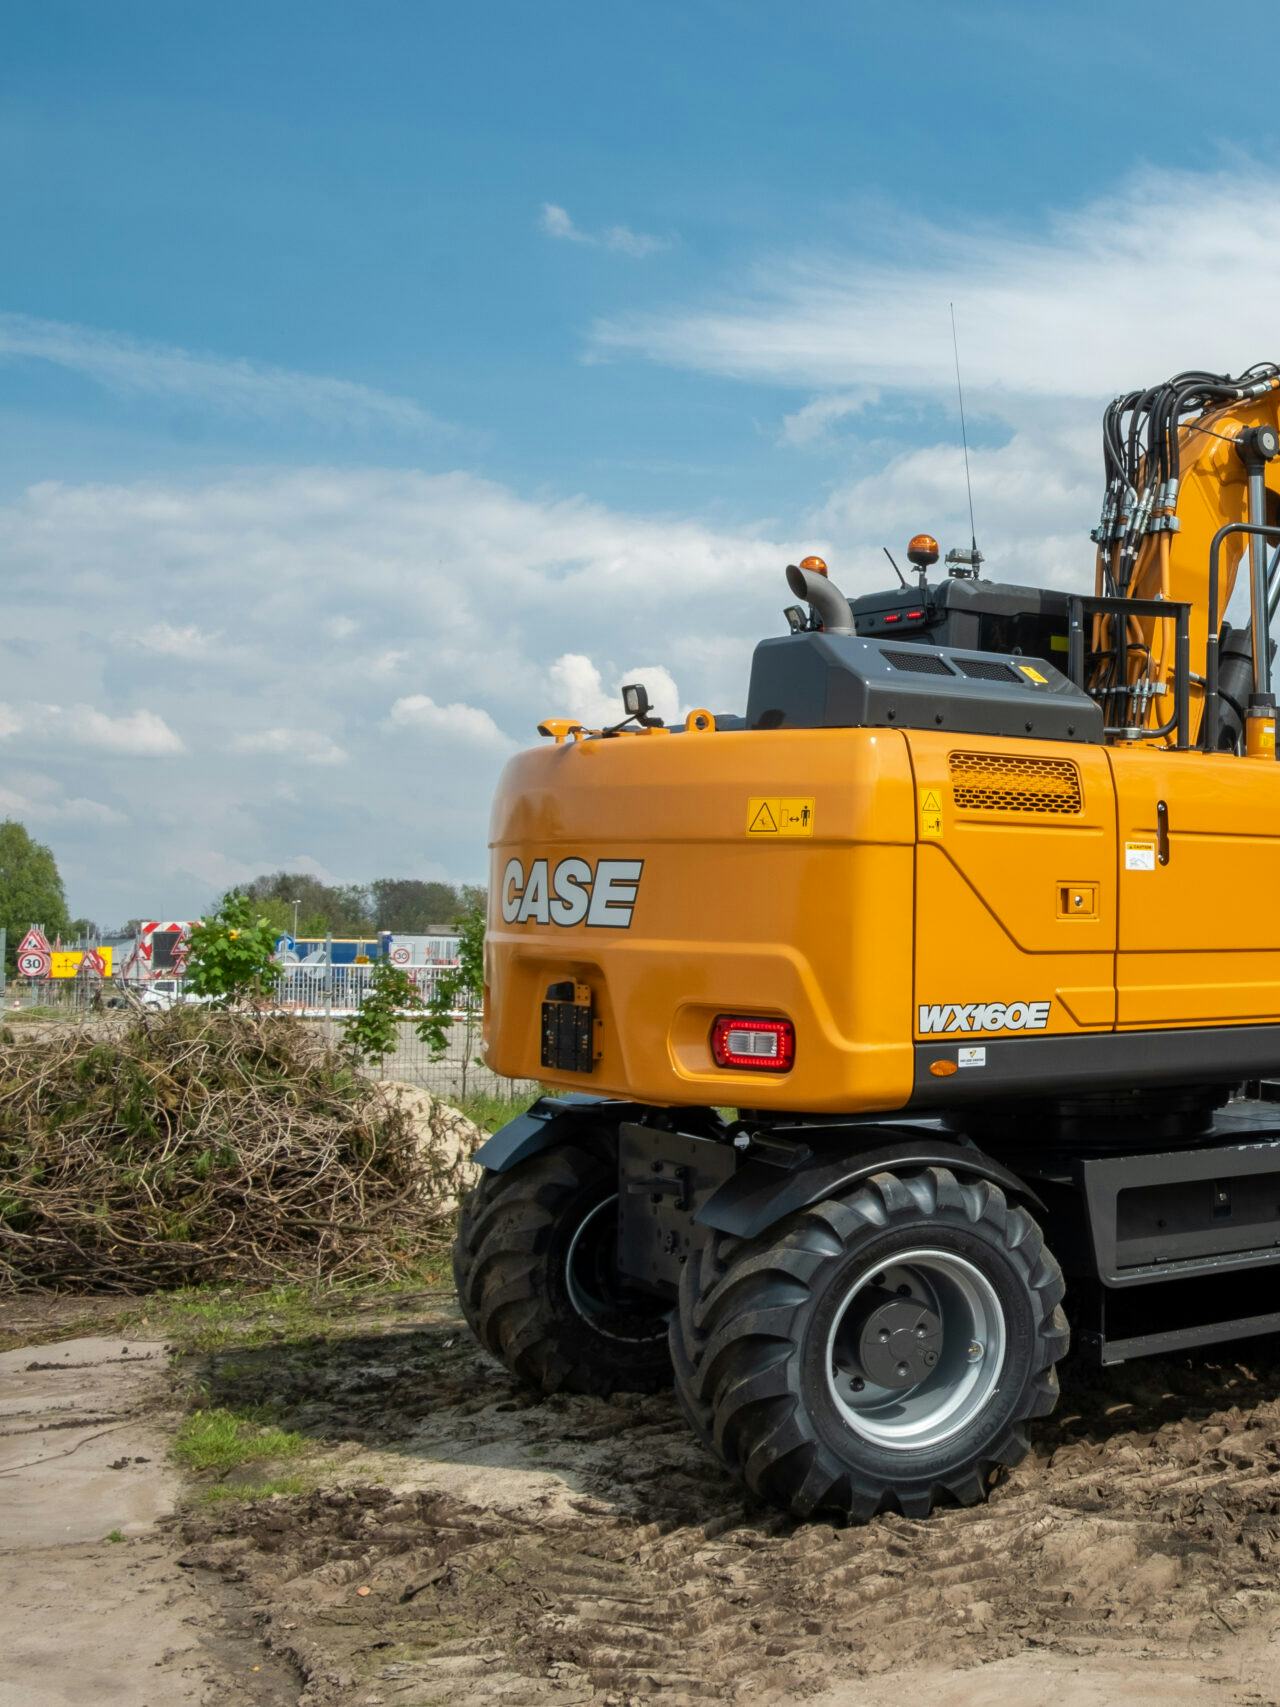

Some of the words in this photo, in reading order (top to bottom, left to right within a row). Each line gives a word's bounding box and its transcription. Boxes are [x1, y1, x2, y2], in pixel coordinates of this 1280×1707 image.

[502, 856, 645, 928] CASE
[24, 958, 41, 969] 30
[918, 1001, 1051, 1034] WX160E
